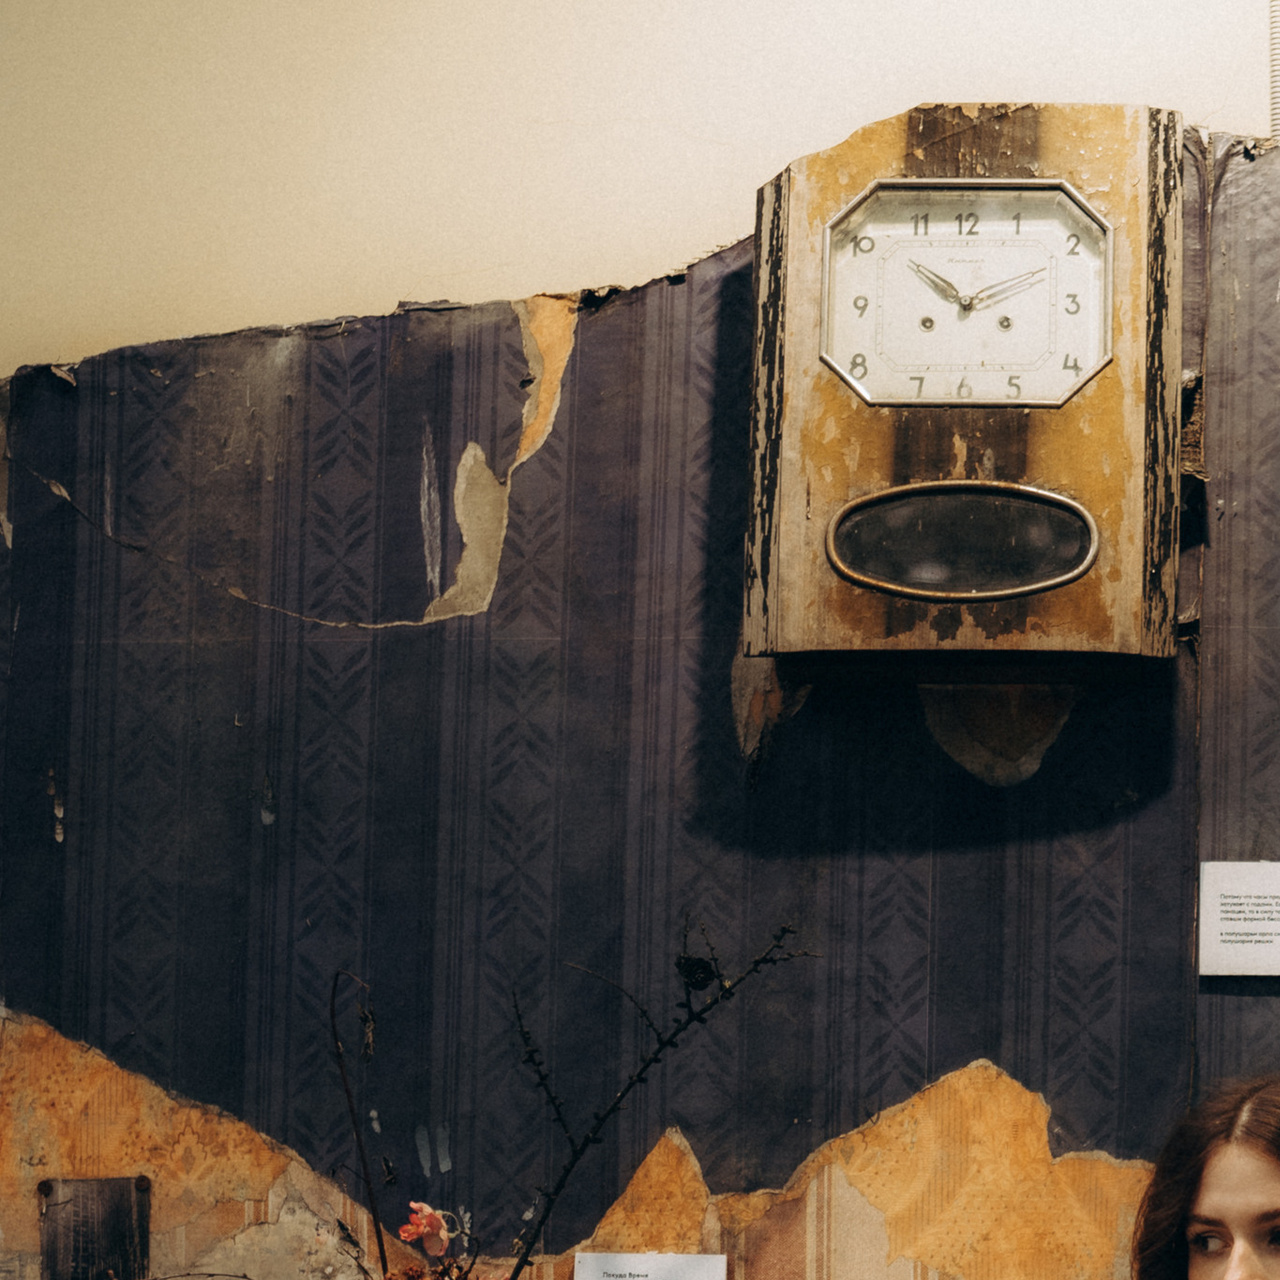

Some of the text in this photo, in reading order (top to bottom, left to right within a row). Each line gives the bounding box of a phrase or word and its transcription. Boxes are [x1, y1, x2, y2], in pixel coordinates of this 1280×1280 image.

[910, 212, 1022, 236] 11 12 1
[849, 235, 875, 257] 10
[1066, 234, 1081, 256] 2
[853, 295, 869, 318] 9
[1065, 294, 1081, 315] 3
[849, 353, 868, 380] 8
[1062, 353, 1083, 378] 4
[909, 376, 925, 399] 7
[956, 377, 973, 399] 6
[1006, 375, 1022, 399] 5
